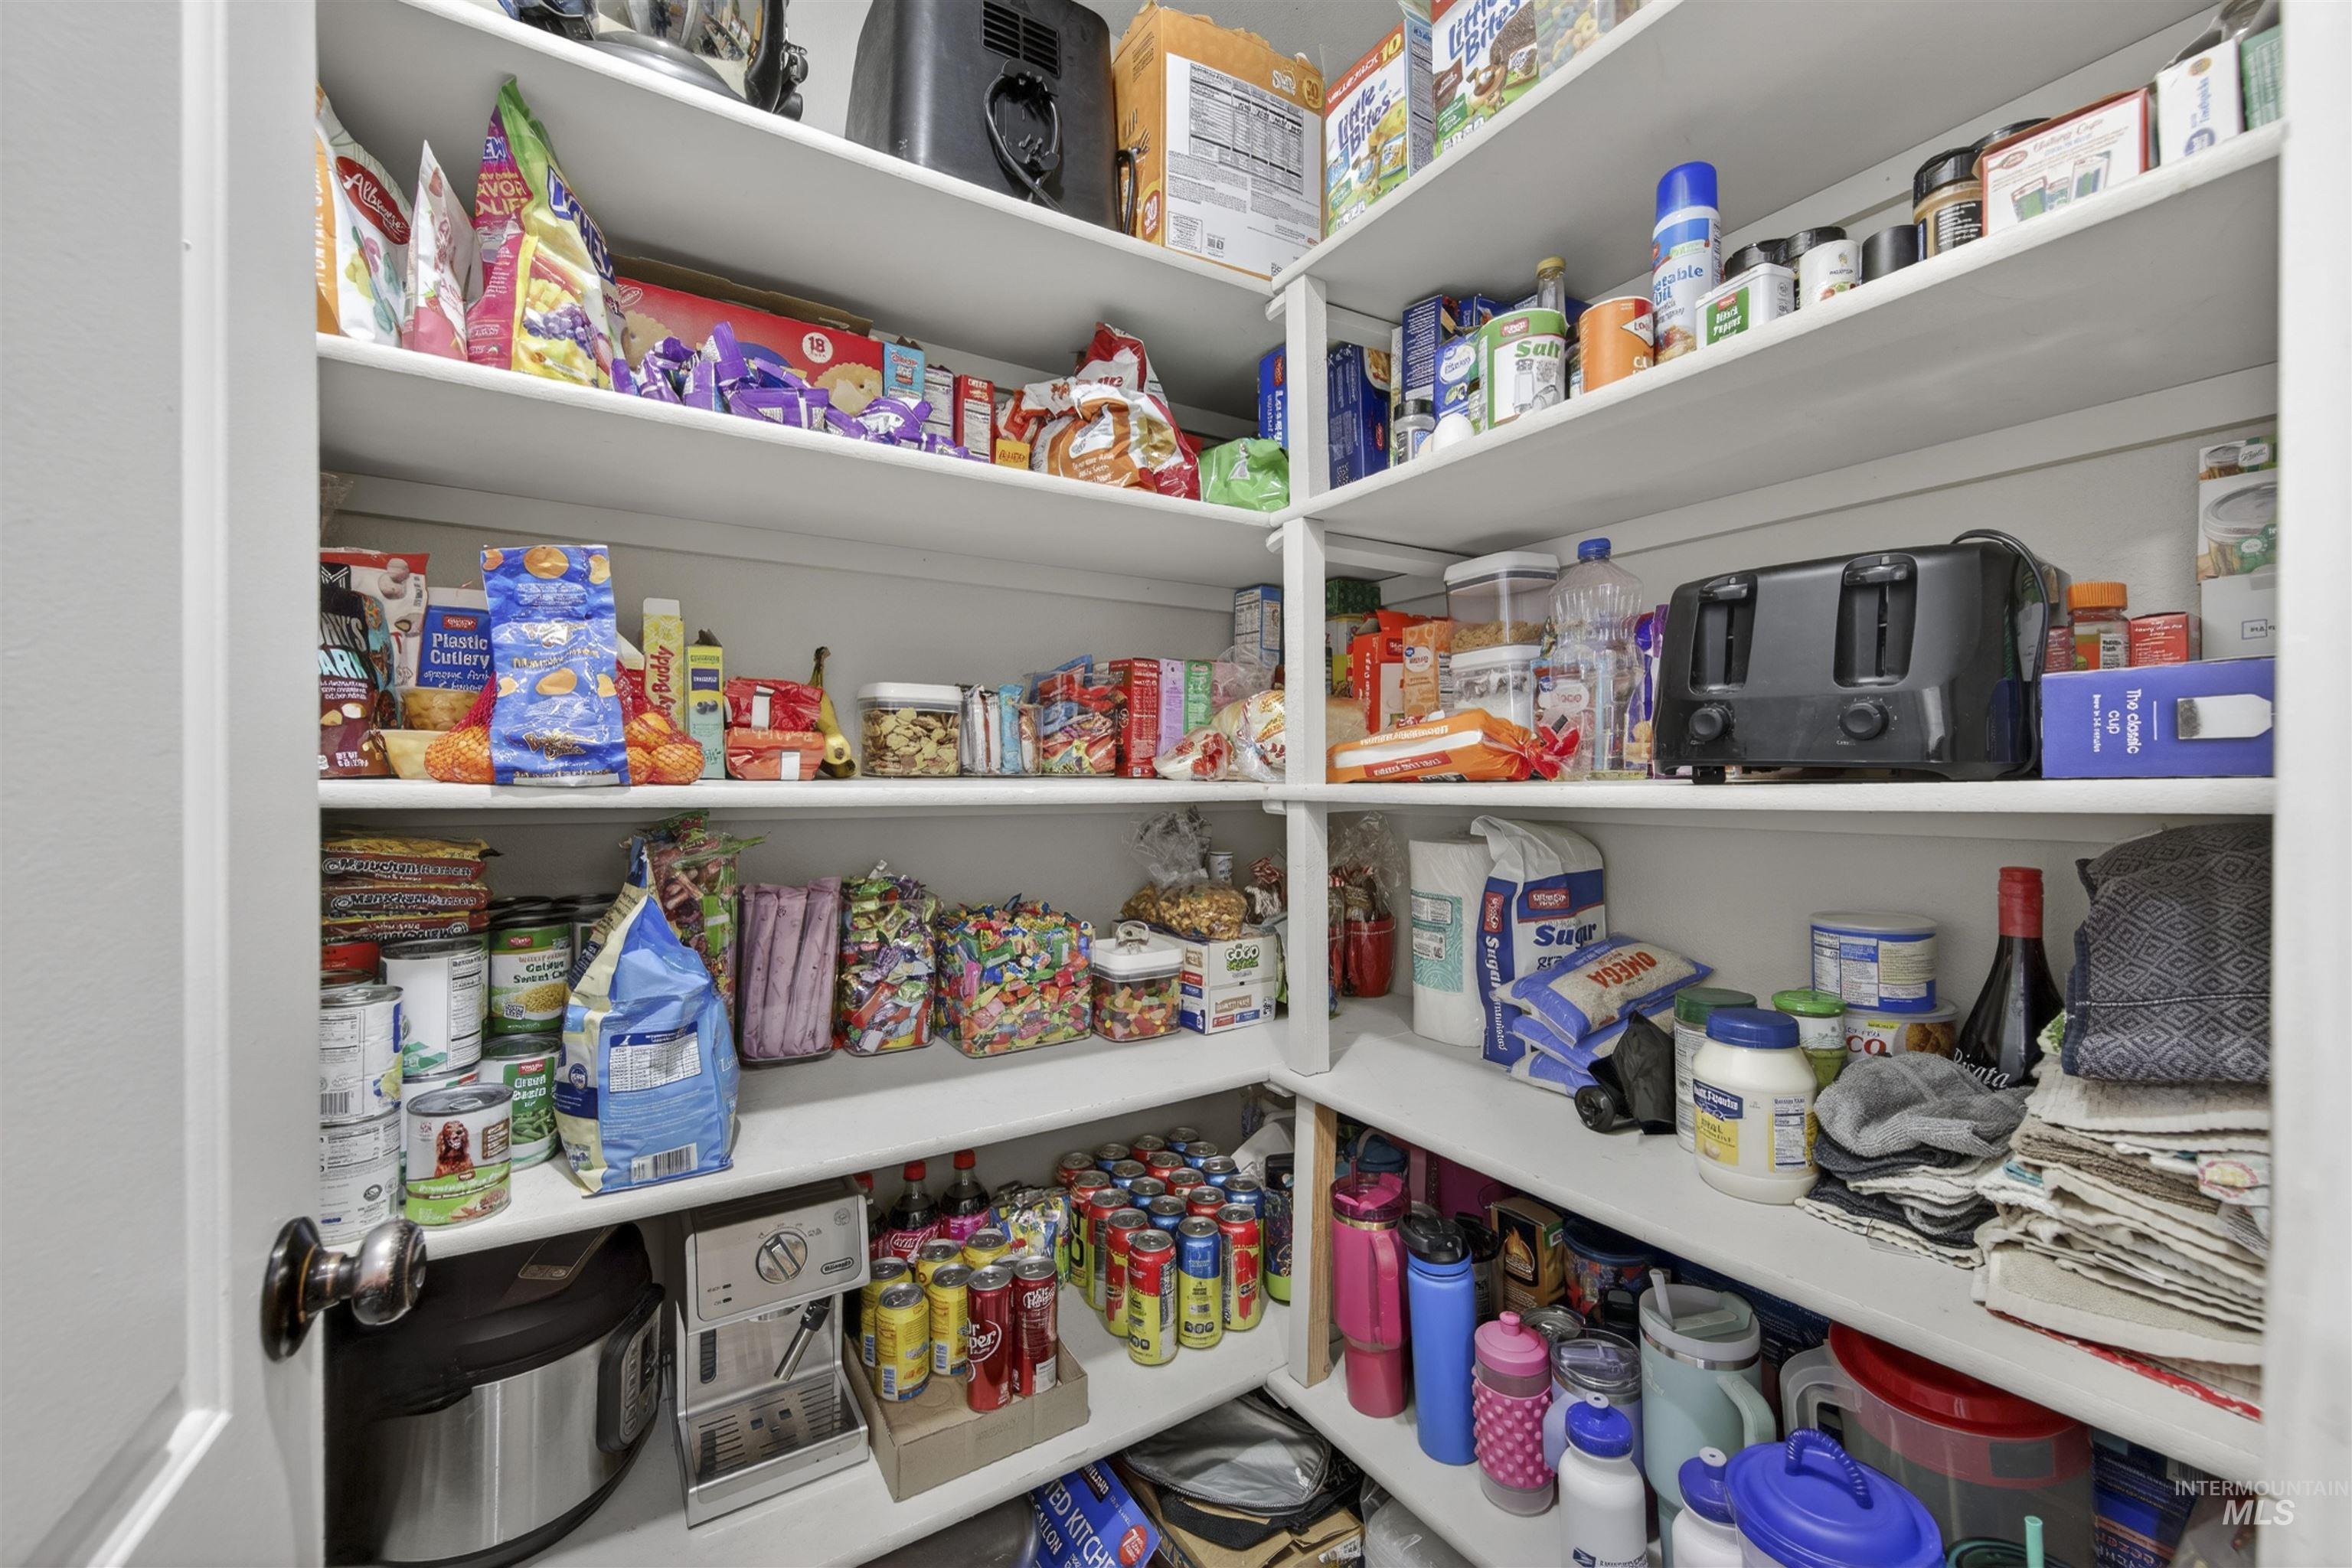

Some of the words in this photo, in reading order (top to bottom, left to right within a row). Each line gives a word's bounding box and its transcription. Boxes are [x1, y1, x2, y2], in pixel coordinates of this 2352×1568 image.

[1380, 33, 1402, 62] 10
[1465, 0, 1521, 67] Bites
[1337, 84, 1376, 150] Little
[1349, 93, 1392, 155] Bites
[808, 335, 825, 353] 18
[1514, 339, 1561, 358] Salt
[432, 632, 488, 651] Plastic
[430, 649, 491, 670] Cutlery
[650, 644, 675, 697] Buddy
[2125, 688, 2142, 711] The
[2106, 710, 2121, 735] cup
[2125, 712, 2143, 755] classic
[1533, 923, 1597, 949] Sugar
[1485, 935, 1503, 989] Sugar
[1586, 950, 1658, 990] OMEGA
